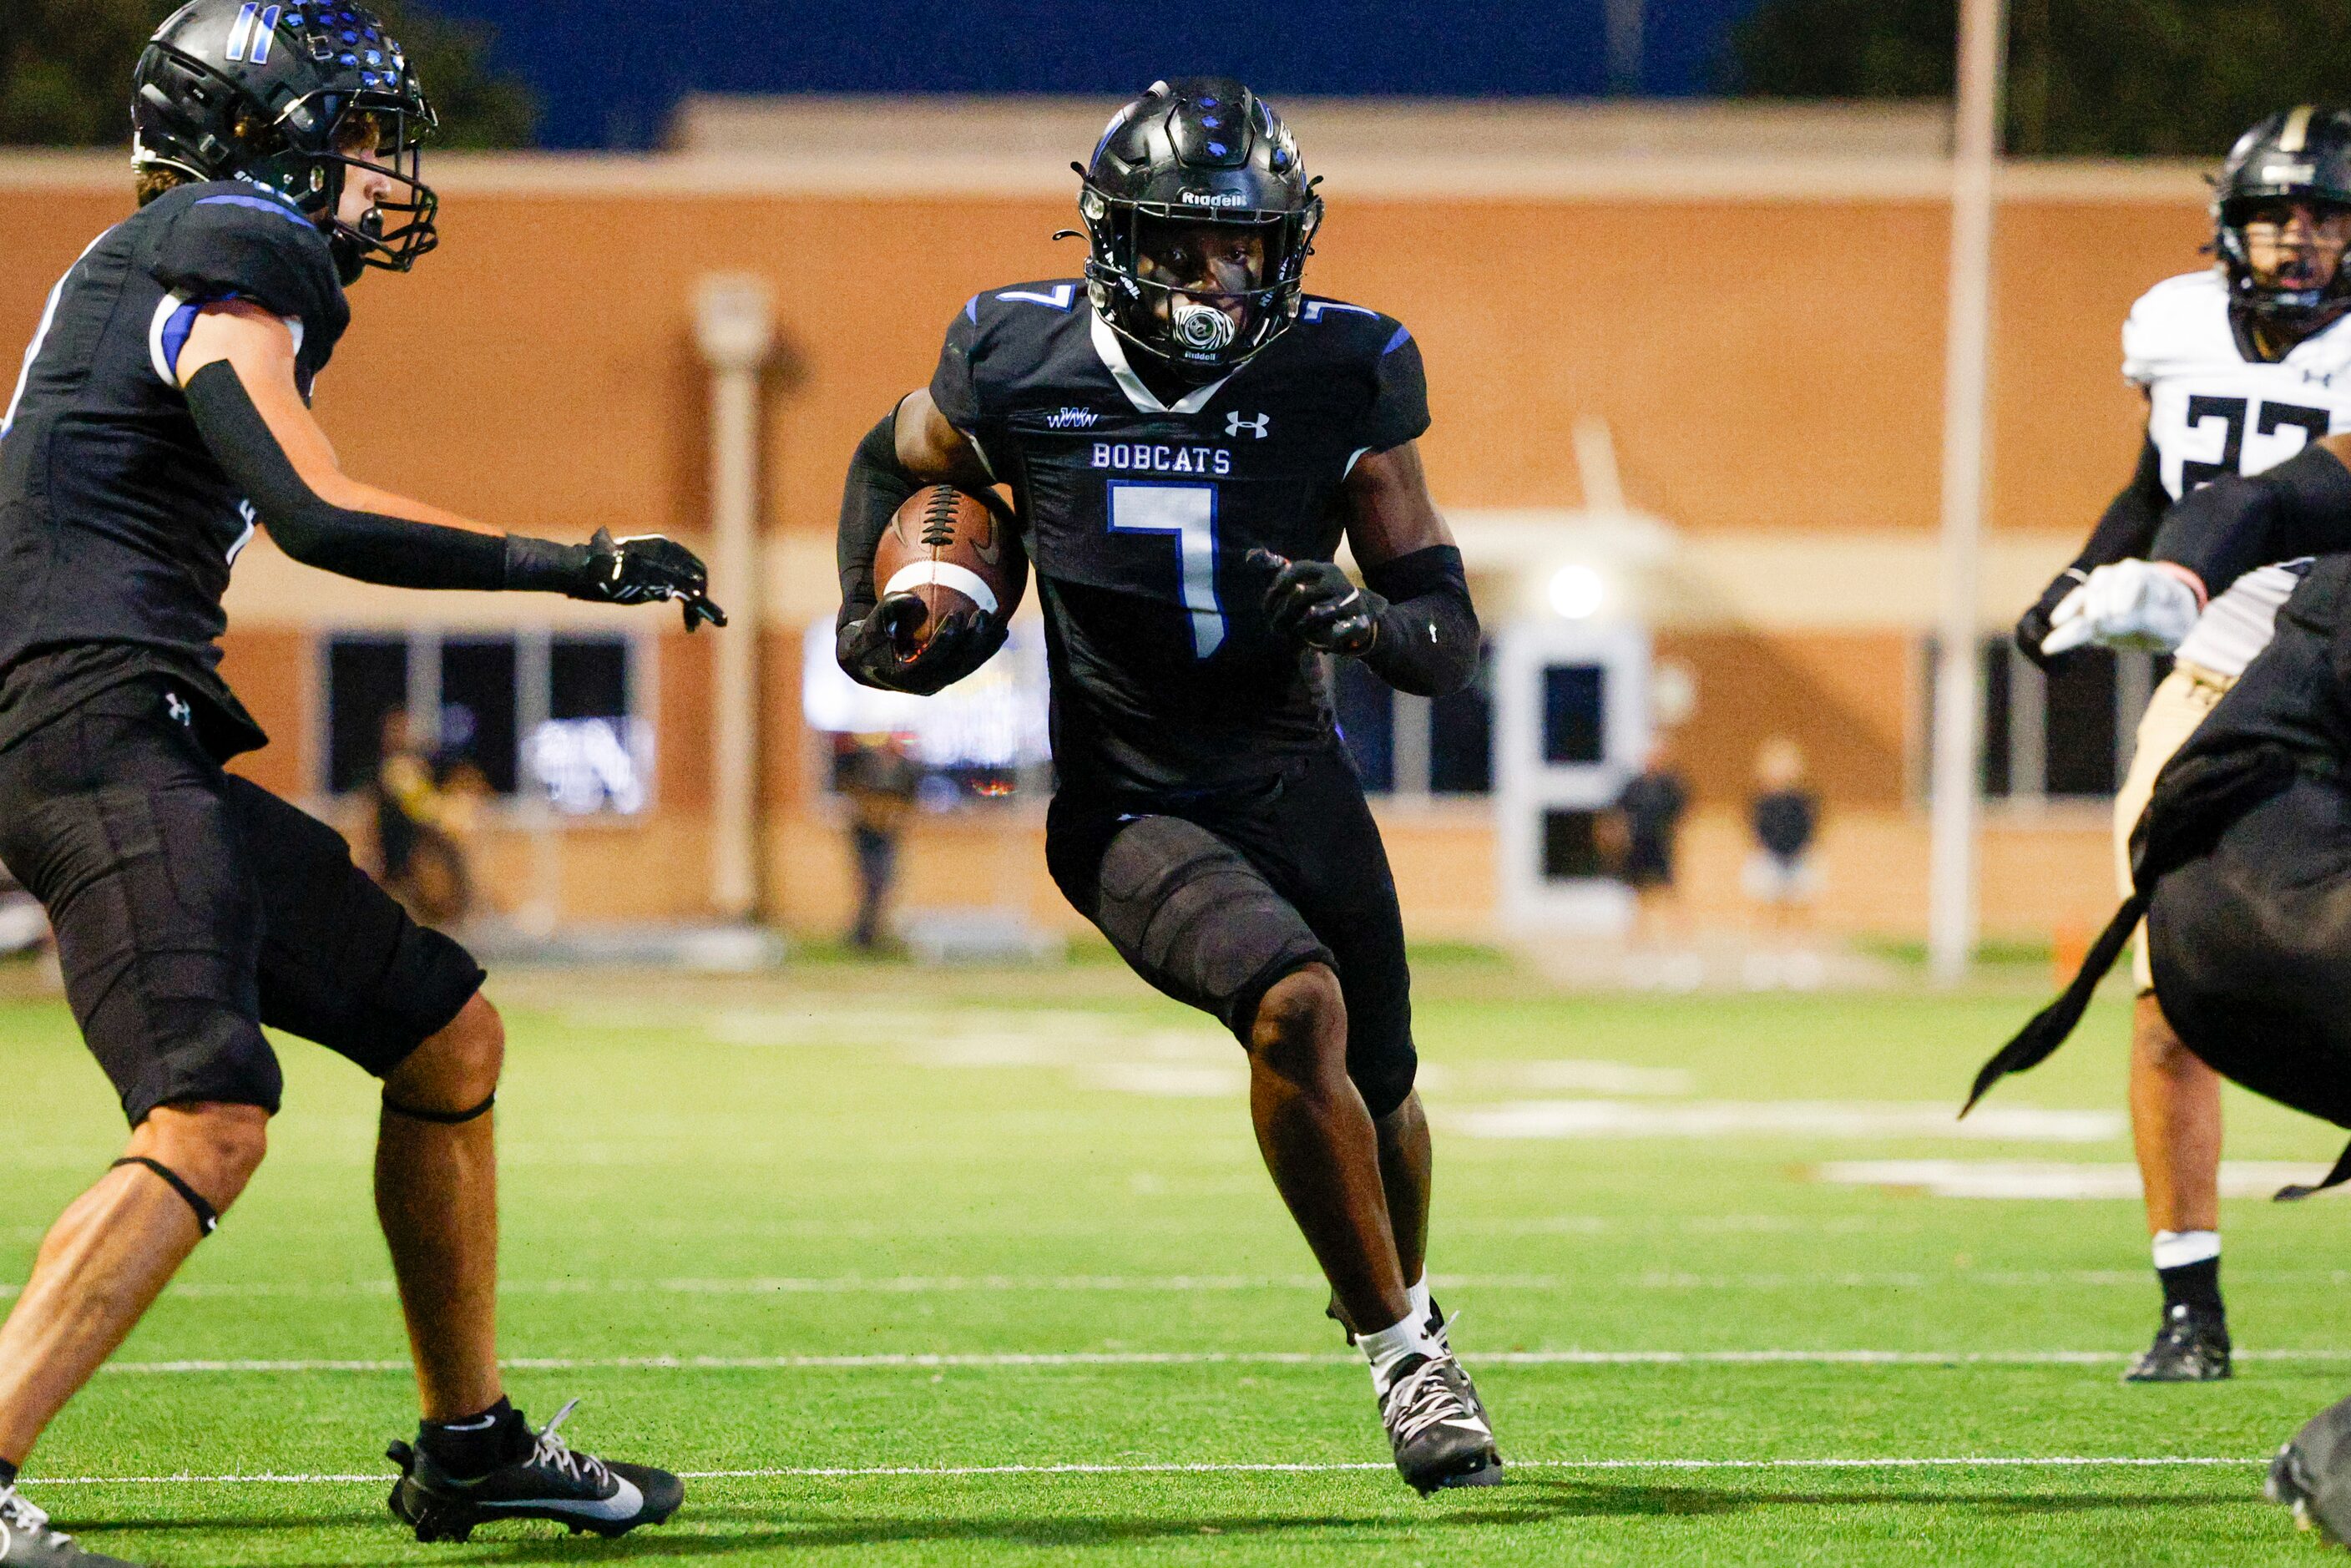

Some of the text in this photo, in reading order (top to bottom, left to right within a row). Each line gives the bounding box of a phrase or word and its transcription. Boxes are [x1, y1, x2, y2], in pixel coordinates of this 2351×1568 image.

[225, 2, 281, 64] 11
[1181, 191, 1247, 206] Riddell
[1091, 443, 1232, 474] BOBCATS
[1106, 479, 1230, 660] 7
